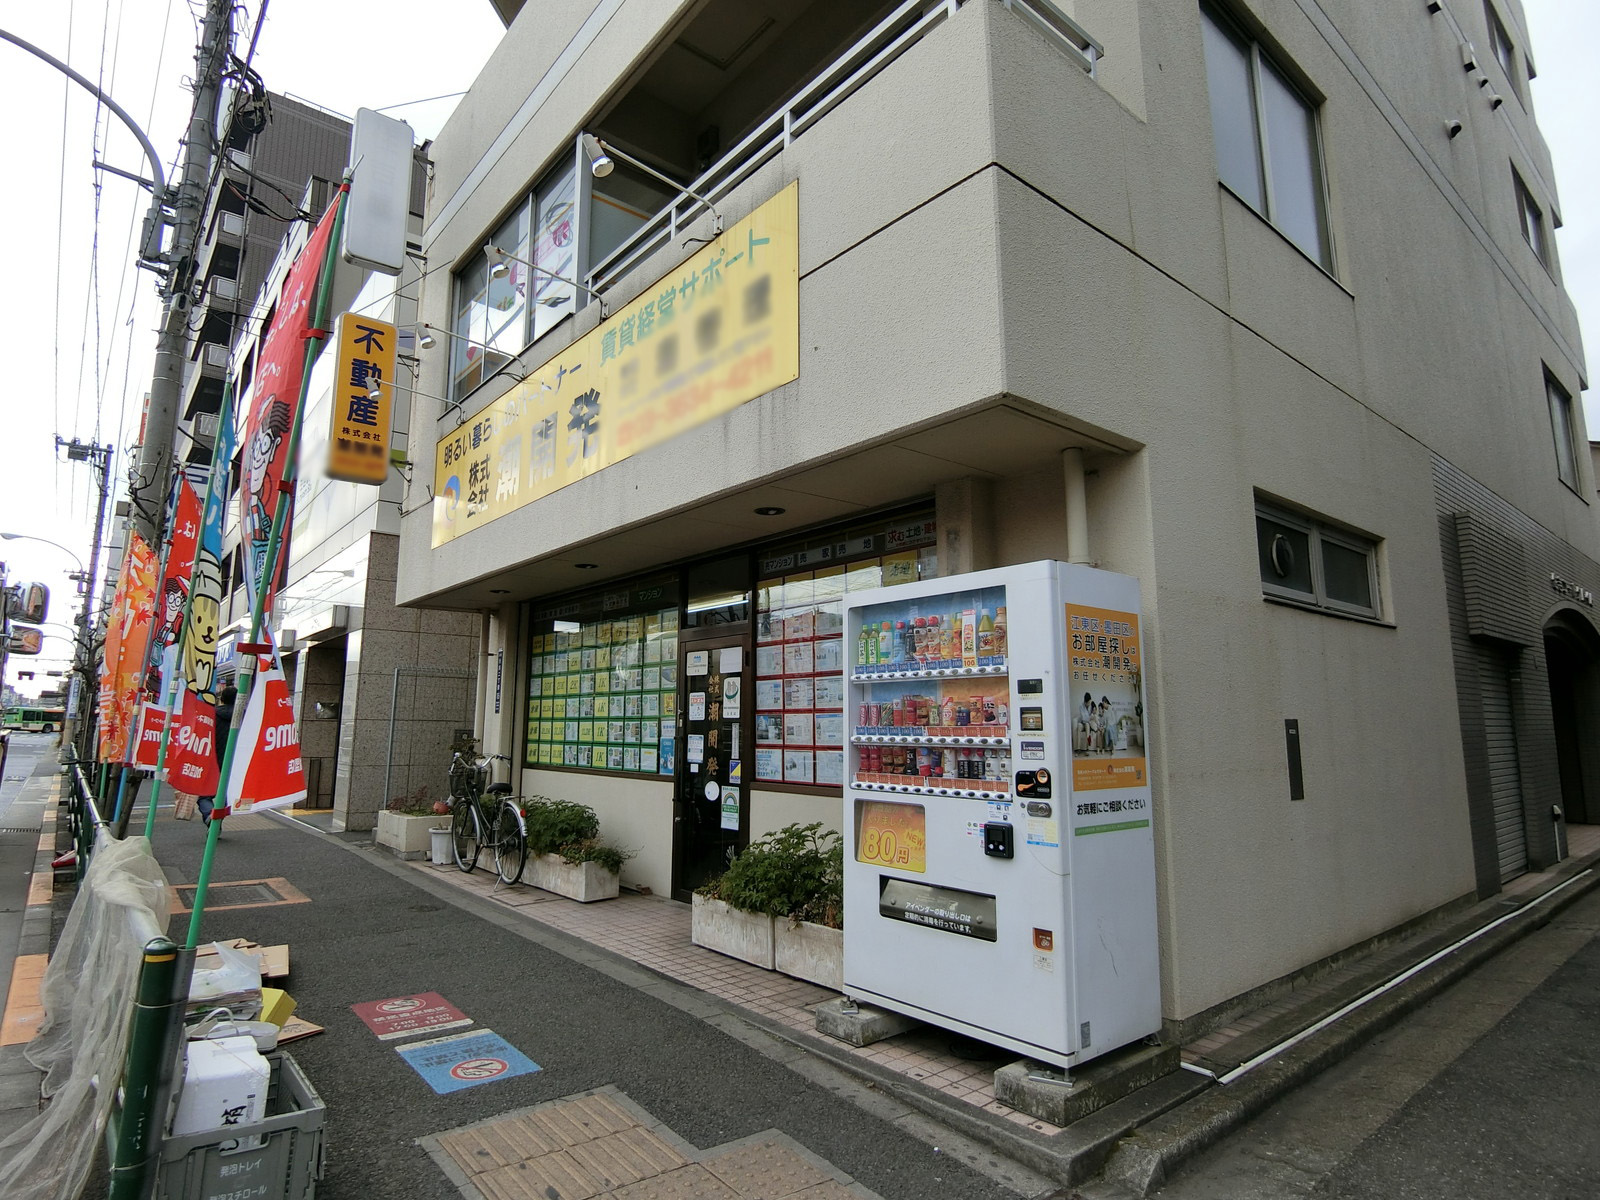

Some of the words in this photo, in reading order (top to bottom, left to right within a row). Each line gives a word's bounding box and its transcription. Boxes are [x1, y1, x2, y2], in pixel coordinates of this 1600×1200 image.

[600, 228, 771, 367] 賃貸経営サポート
[346, 323, 385, 427] 不動産
[341, 427, 382, 442] 株式会社
[467, 453, 491, 490] 株式
[1077, 799, 1146, 815] お気軽にご相談ください
[863, 828, 910, 864] 80円
[906, 831, 924, 846] NEW
[220, 1158, 262, 1177] 発泡トレイ
